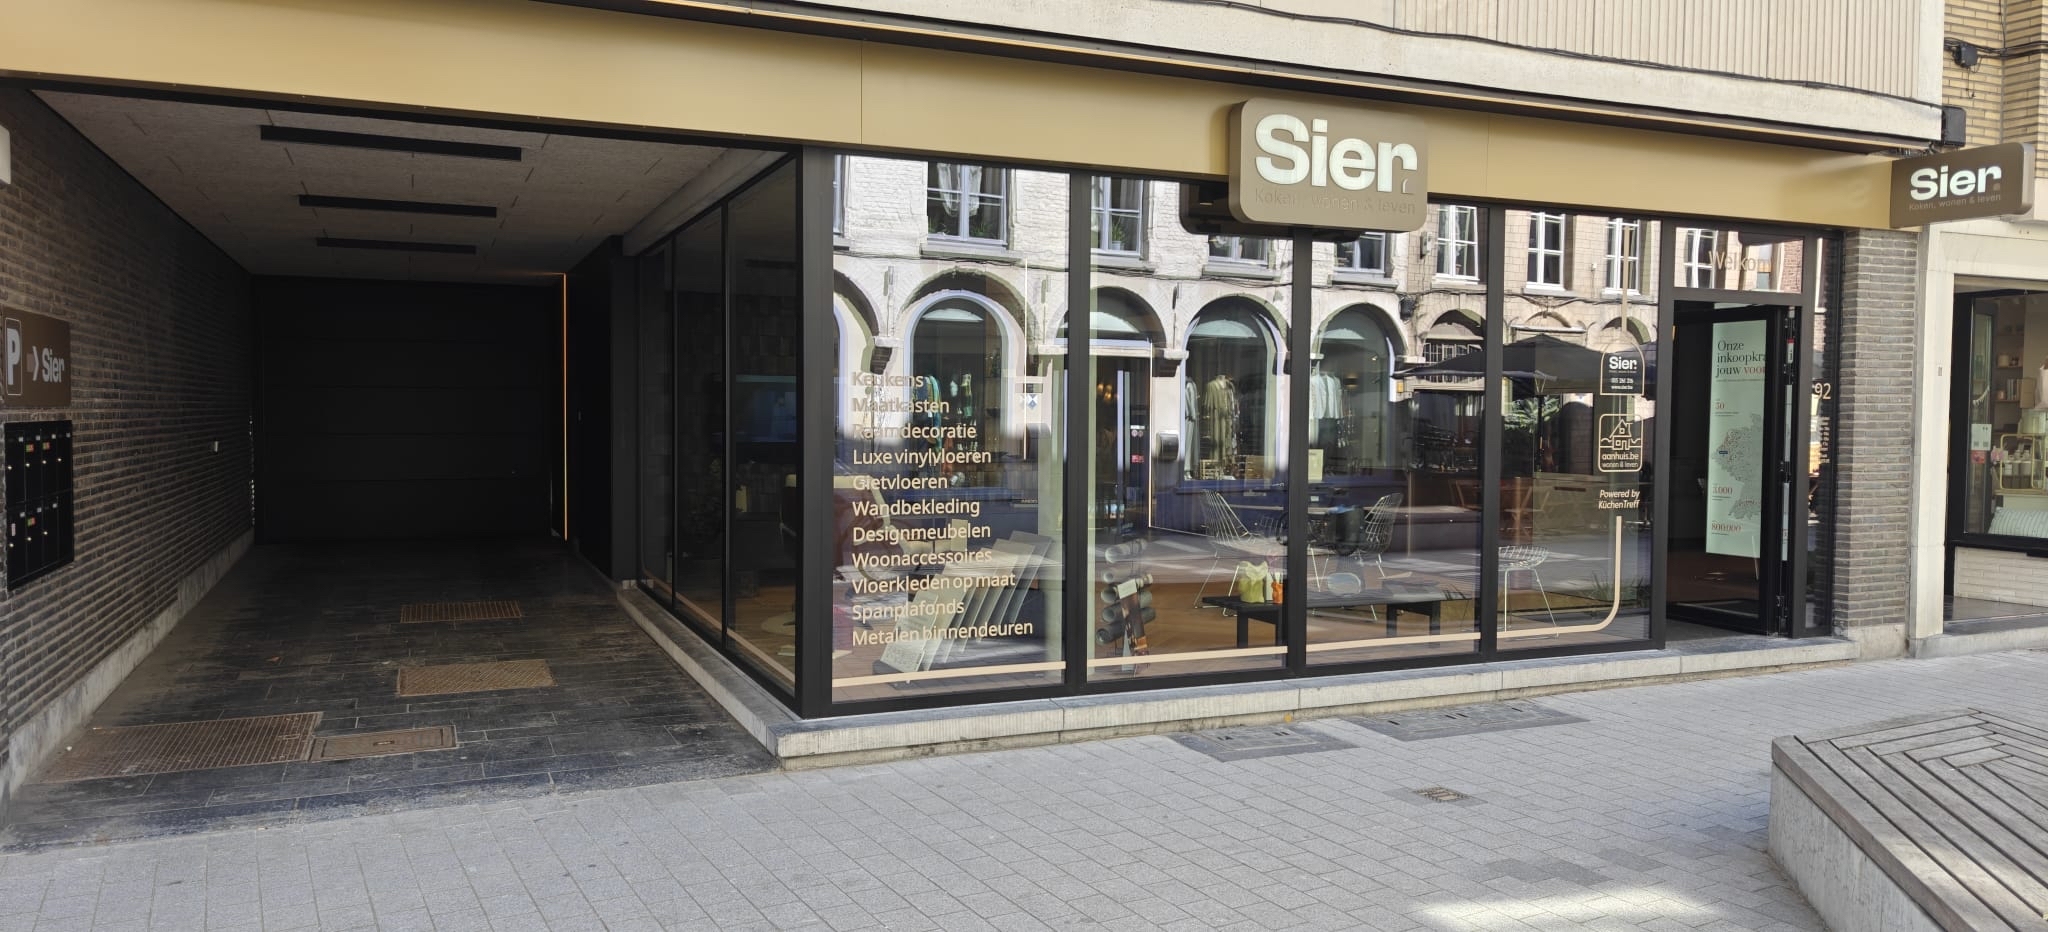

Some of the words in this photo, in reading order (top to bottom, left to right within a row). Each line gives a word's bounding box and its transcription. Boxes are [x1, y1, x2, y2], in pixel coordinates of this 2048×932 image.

[1377, 199, 1416, 215] leven
[1708, 250, 1772, 273] Welkom
[1717, 340, 1745, 352] Onze
[7, 327, 20, 386] P
[42, 347, 65, 383] Sier
[852, 371, 924, 388] Keukens
[1715, 365, 1741, 378] jouw
[852, 398, 950, 413] Maatkasten
[852, 424, 977, 440] Raamdecoratie
[853, 449, 892, 465] Luxe
[894, 448, 991, 468] vinylvloeren
[1602, 452, 1639, 460] aanhuis.be
[852, 475, 949, 491] Gietvloeren
[1600, 490, 1630, 498] Powered
[1632, 490, 1640, 500] by
[852, 499, 980, 518] Wandbekleding
[852, 524, 991, 545] Designmeubelen
[852, 551, 993, 569] Woonaccessoires
[852, 576, 949, 594] Vloerkleden
[952, 577, 973, 593] op
[976, 574, 1016, 589] maat
[852, 601, 965, 624] Spanplafonds
[852, 628, 920, 647] Metalen
[923, 622, 1033, 641] binnendeuren
